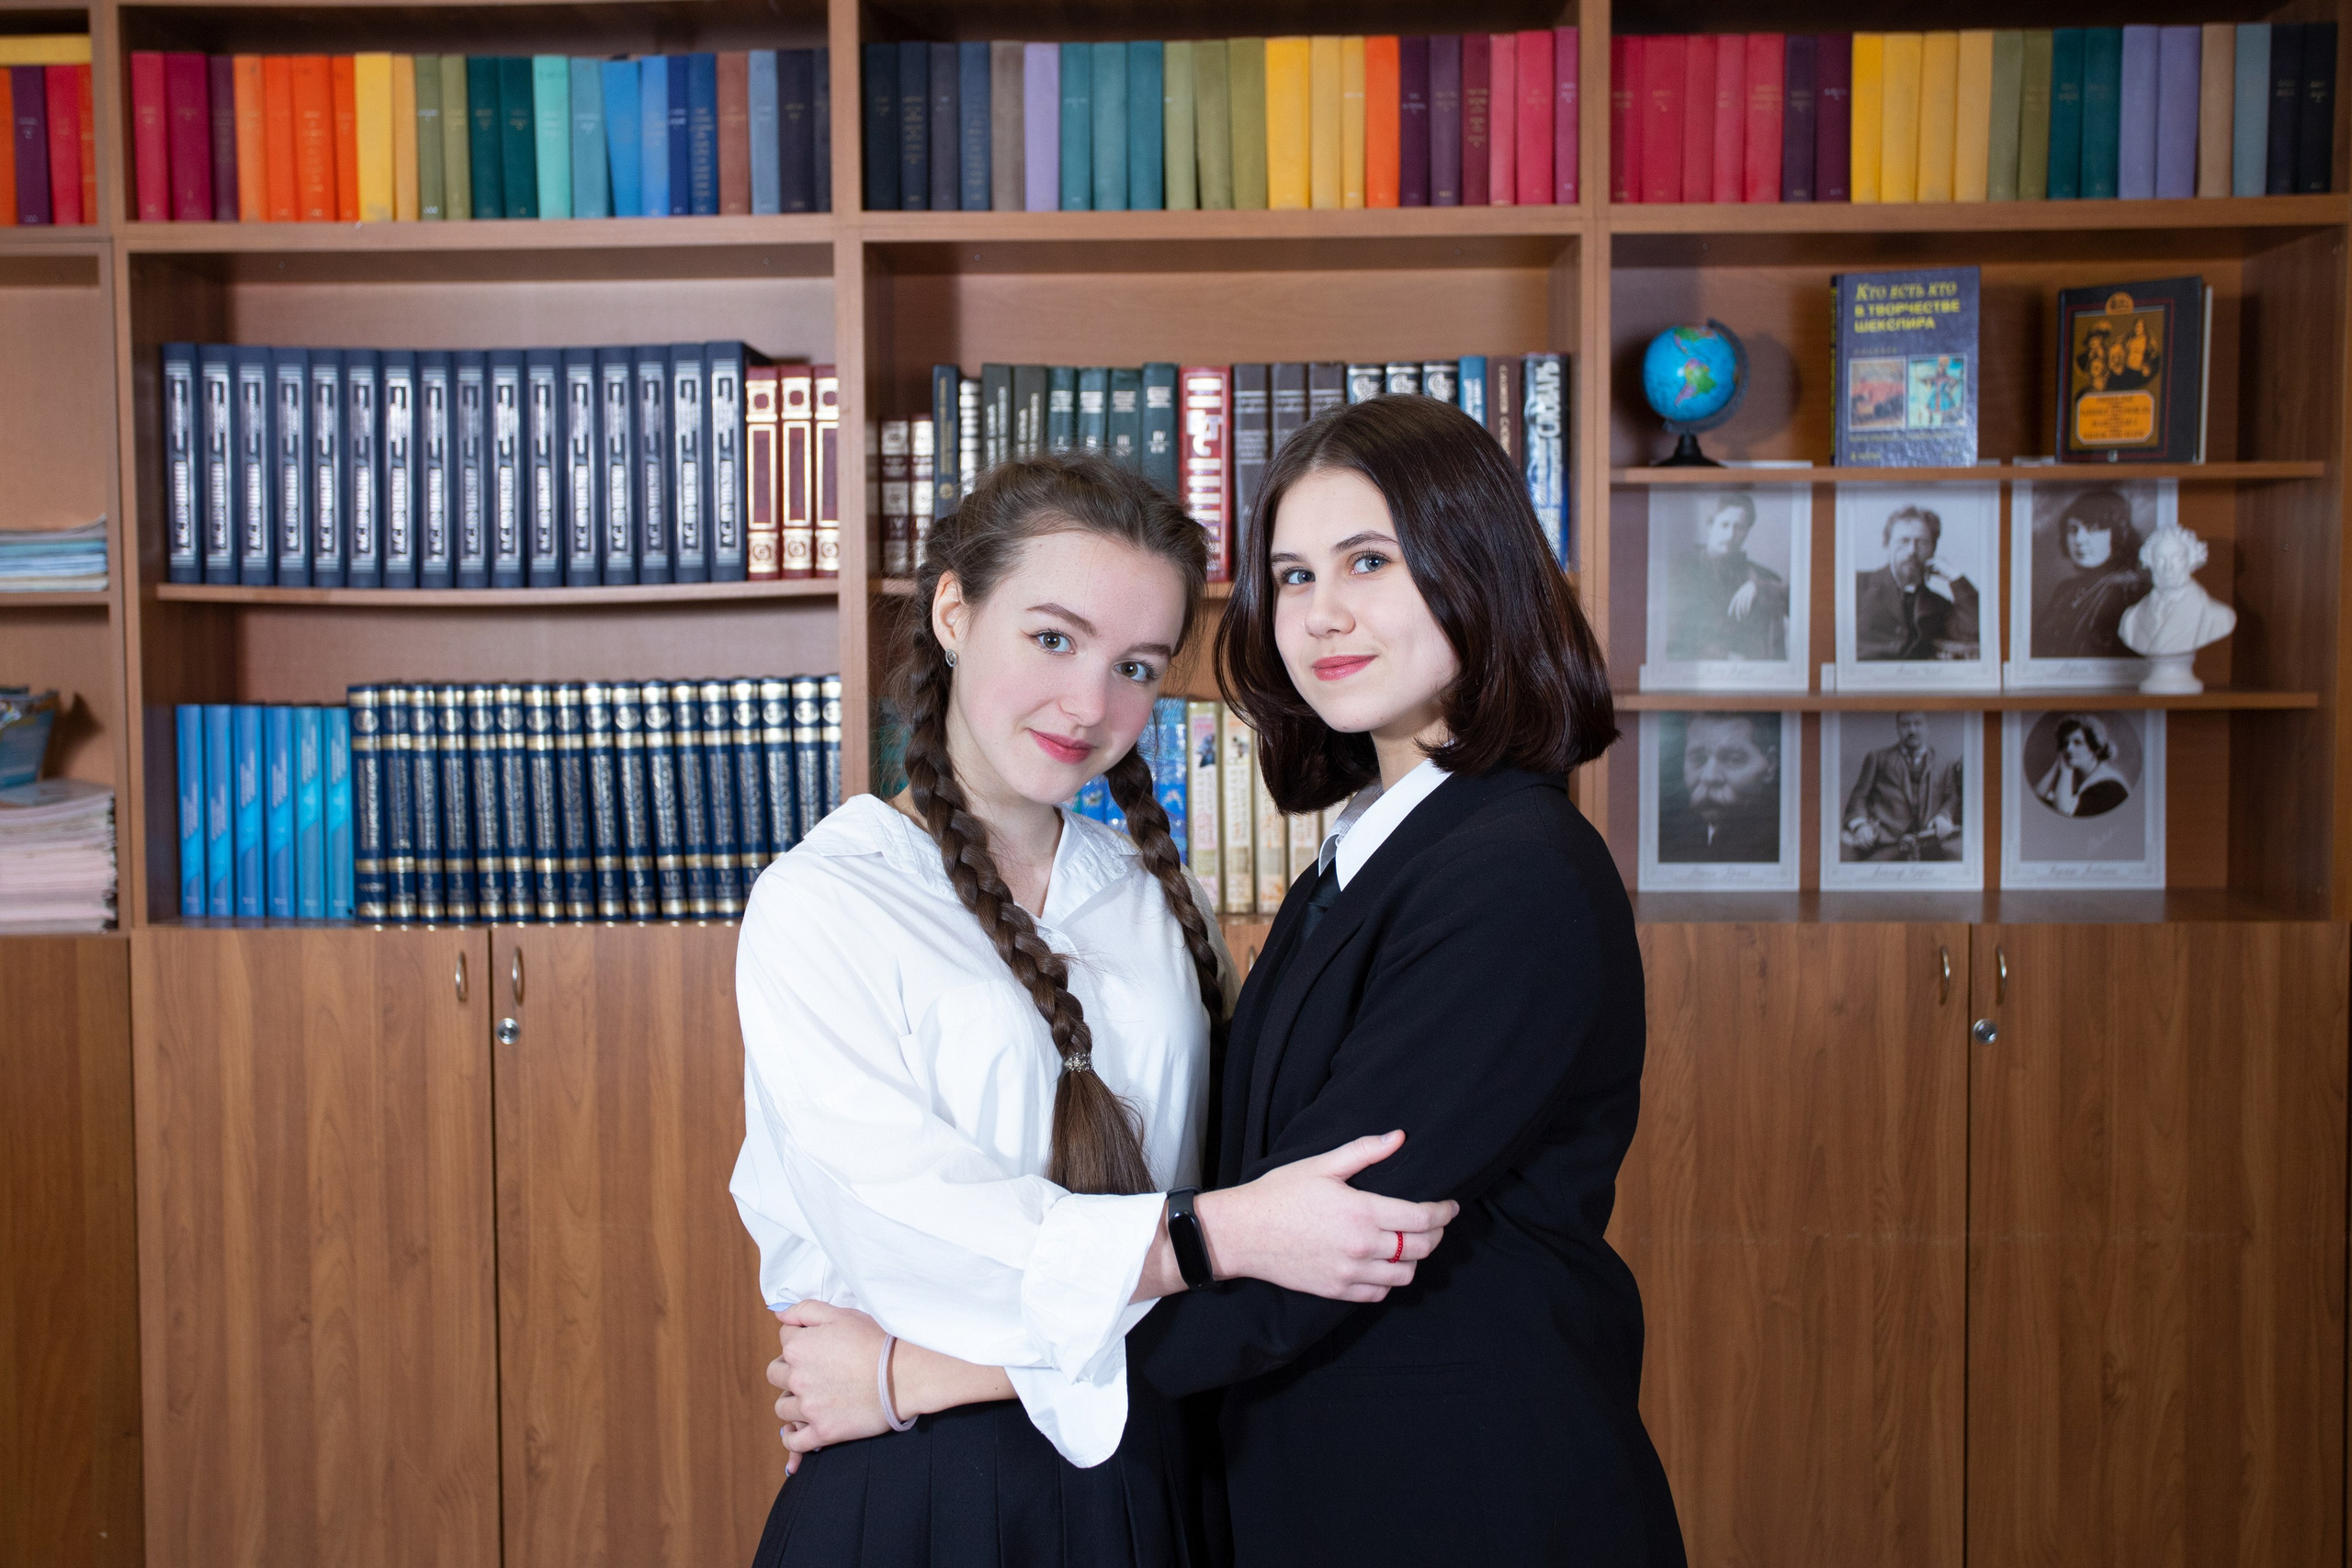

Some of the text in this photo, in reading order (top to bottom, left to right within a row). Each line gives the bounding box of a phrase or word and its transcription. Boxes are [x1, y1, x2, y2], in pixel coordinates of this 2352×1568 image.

[1854, 299, 1961, 318] В ТВОРЧЕСТВЕ
[1854, 316, 1936, 333] ШЕКСПИРА
[1536, 361, 1560, 437] СЛОВАРЬ
[665, 871, 680, 886] 10
[720, 871, 735, 884] 12
